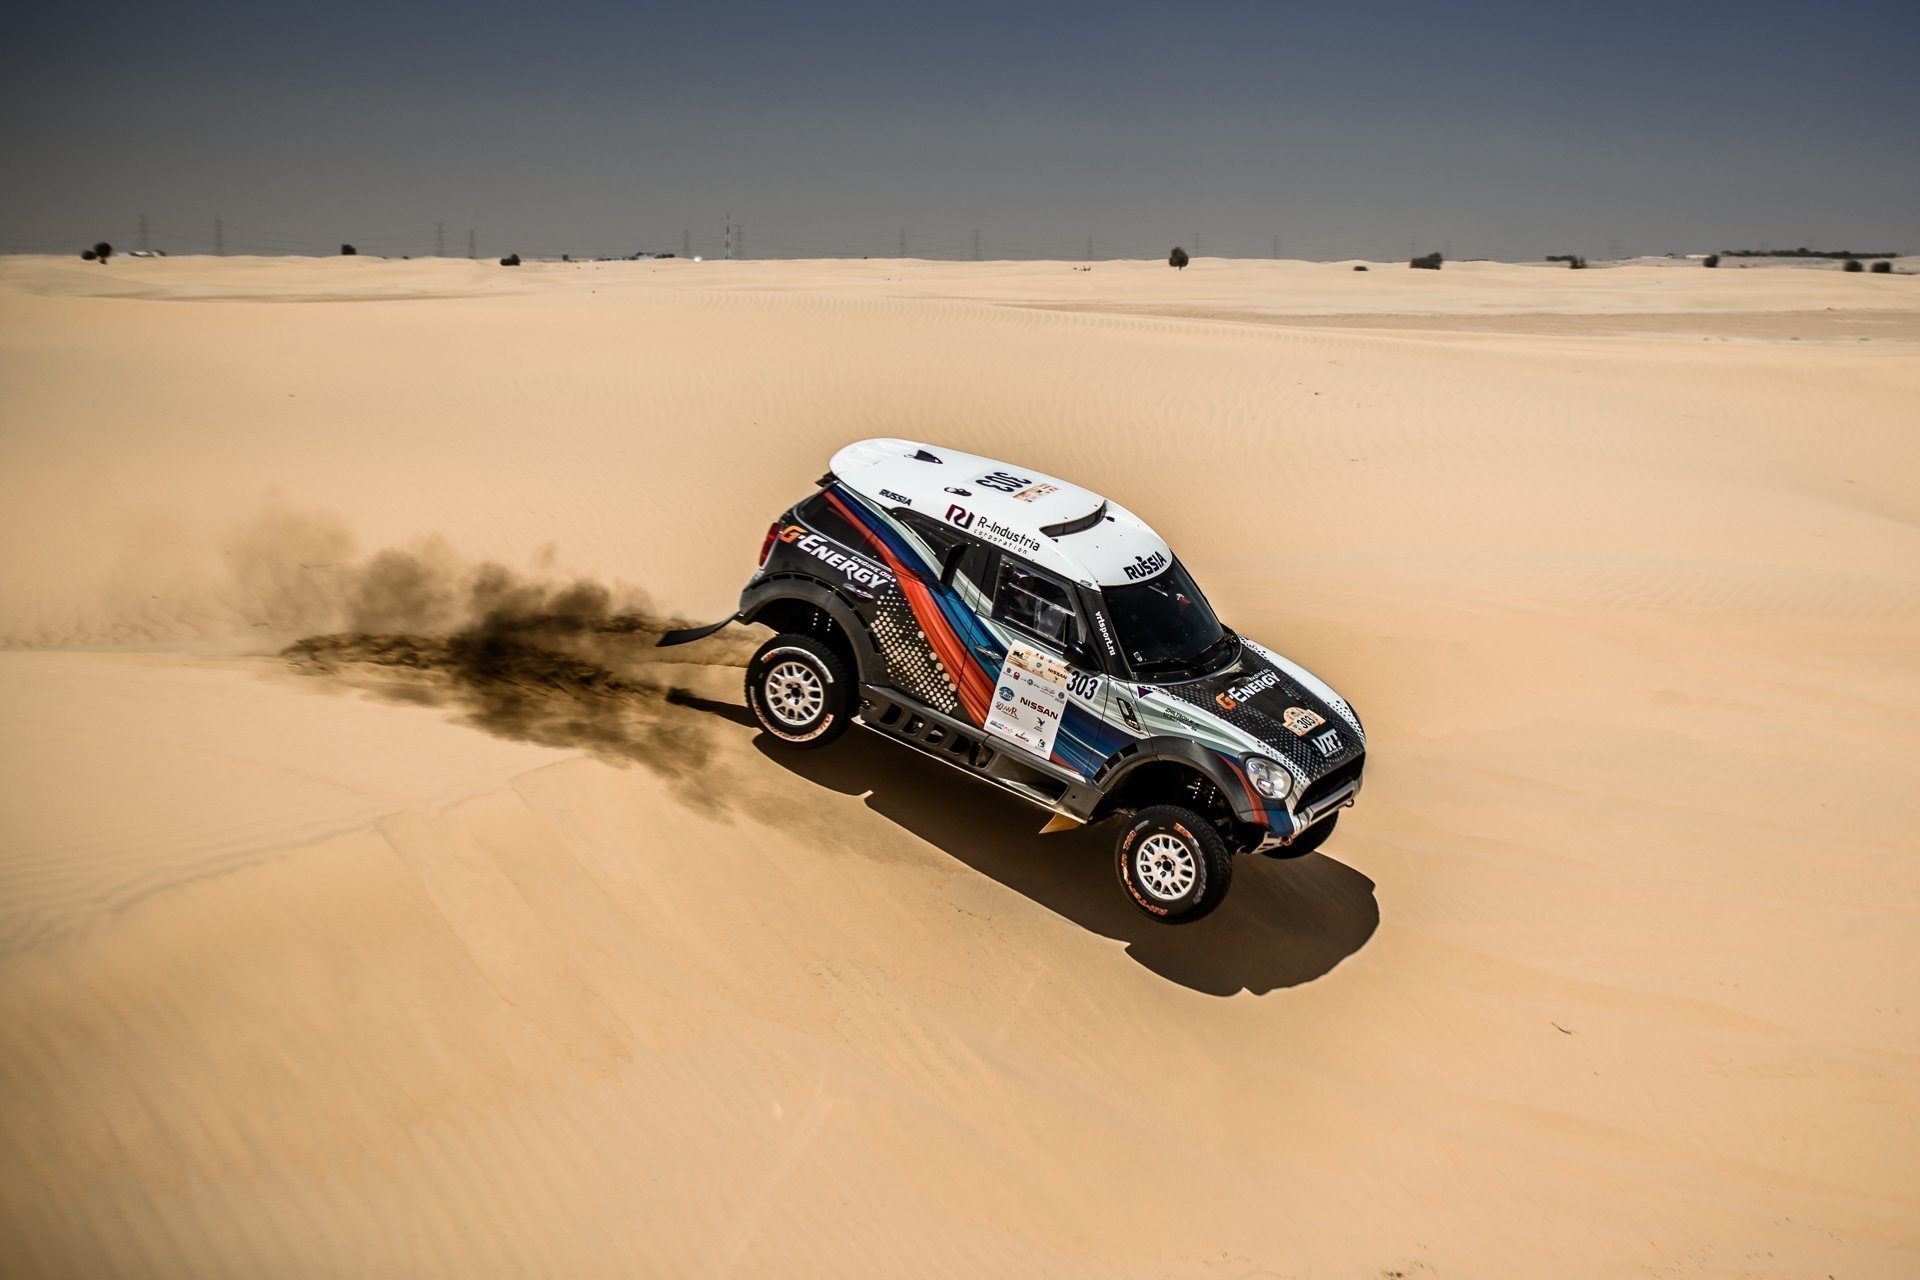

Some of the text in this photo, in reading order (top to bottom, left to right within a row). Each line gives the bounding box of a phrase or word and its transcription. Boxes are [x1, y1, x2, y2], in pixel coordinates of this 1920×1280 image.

[975, 472, 1032, 492] 303
[879, 489, 912, 506] RUSSIA
[974, 529, 1028, 554] corporation
[977, 516, 1040, 551] R-Industria
[1123, 551, 1167, 580] RUSSIA
[1095, 611, 1116, 656] vrtsport.ru
[1048, 668, 1067, 680] NISSAN
[1066, 671, 1099, 700] 303
[1020, 697, 1058, 720] NISSAN
[1297, 715, 1316, 729] 303
[1312, 728, 1342, 754] VRT
